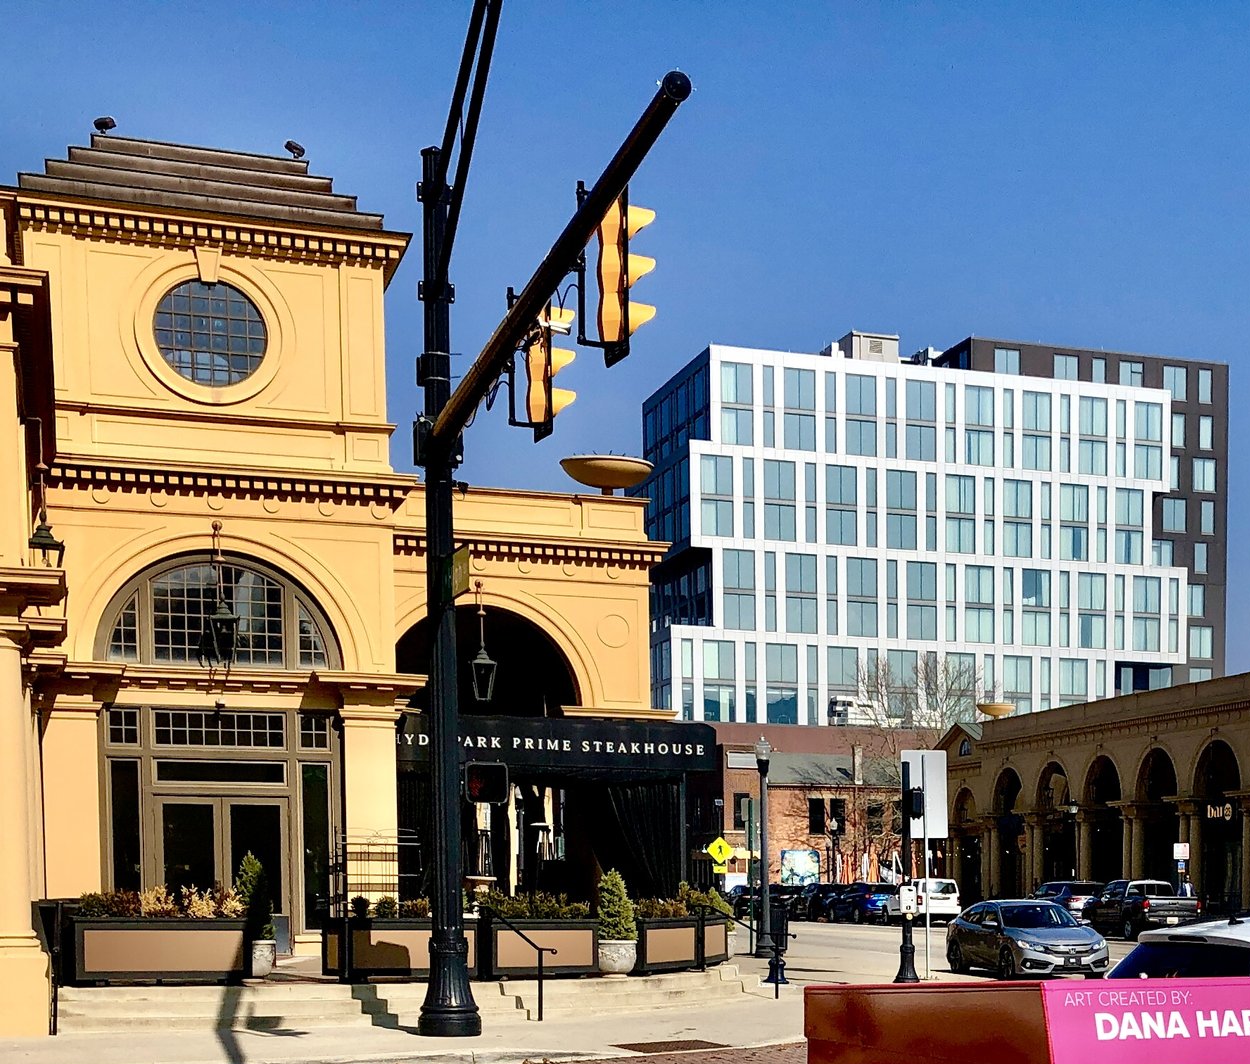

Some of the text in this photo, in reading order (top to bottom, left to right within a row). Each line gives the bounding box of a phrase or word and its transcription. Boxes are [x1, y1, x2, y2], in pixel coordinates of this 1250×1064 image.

[512, 738, 571, 751] PRIME
[582, 740, 705, 756] STEAKHOUSE
[1064, 990, 1194, 1007] ART CREATED BY:
[1094, 1011, 1190, 1041] DANA
